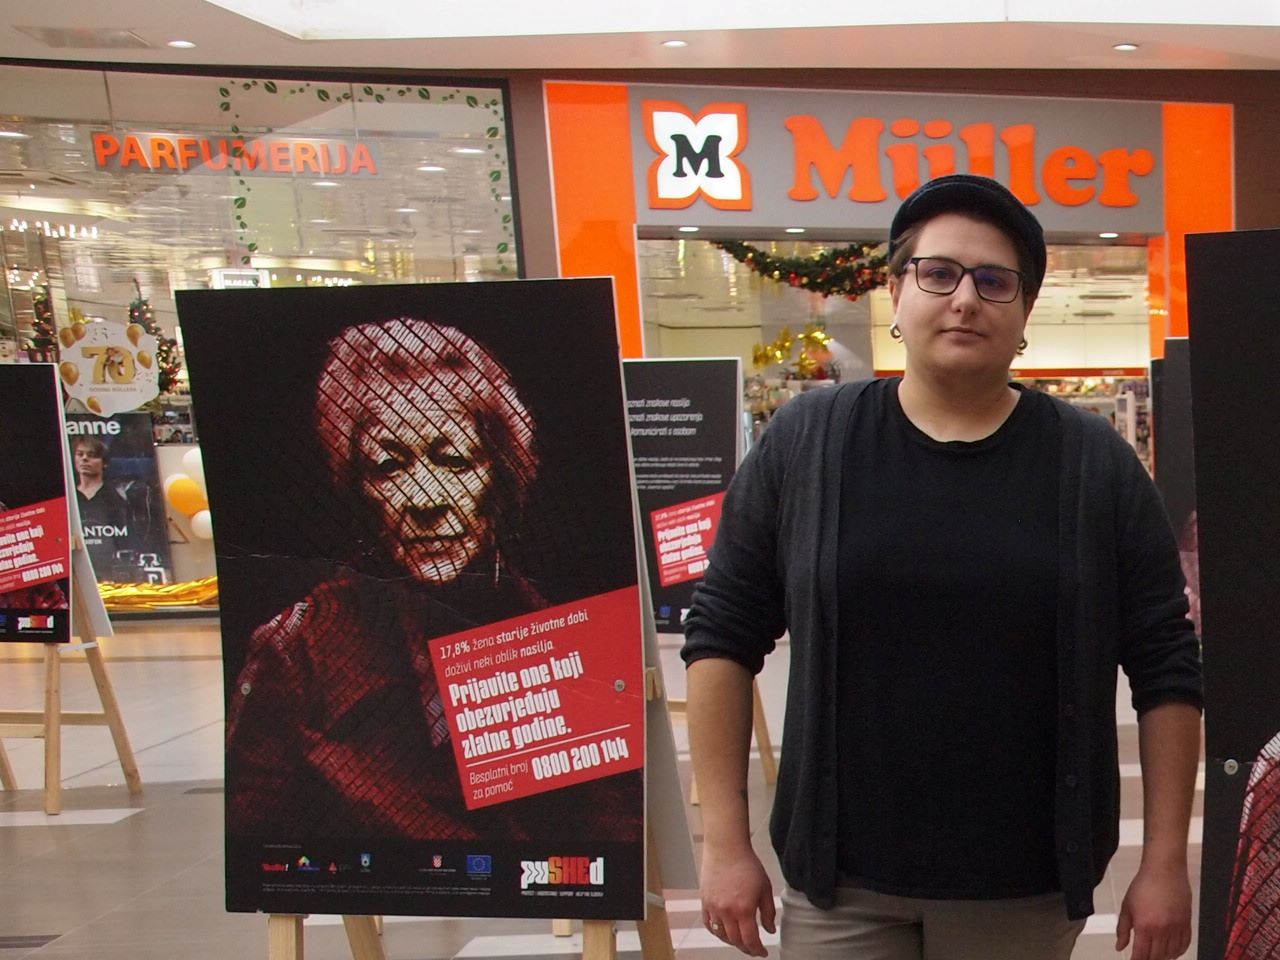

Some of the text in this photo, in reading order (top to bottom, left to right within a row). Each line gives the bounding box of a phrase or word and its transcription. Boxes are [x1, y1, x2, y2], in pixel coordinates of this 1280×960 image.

[93, 132, 378, 175] PARFUMERIJA
[670, 133, 725, 178] M
[784, 115, 1156, 207] Müller
[81, 346, 137, 385] 70
[67, 419, 121, 435] anne
[439, 608, 589, 660] 17,8% žena starije životne dobi
[444, 639, 554, 678] doživi neki oblik nasilja
[449, 651, 584, 707] Prijavite one koji
[455, 687, 561, 733] obezvrjeđuju
[461, 715, 572, 759] zlatne godine.
[469, 737, 629, 785] Besplatni broj 0800 200 144
[472, 779, 514, 800] za pomoć
[520, 856, 605, 889] puSHEd
